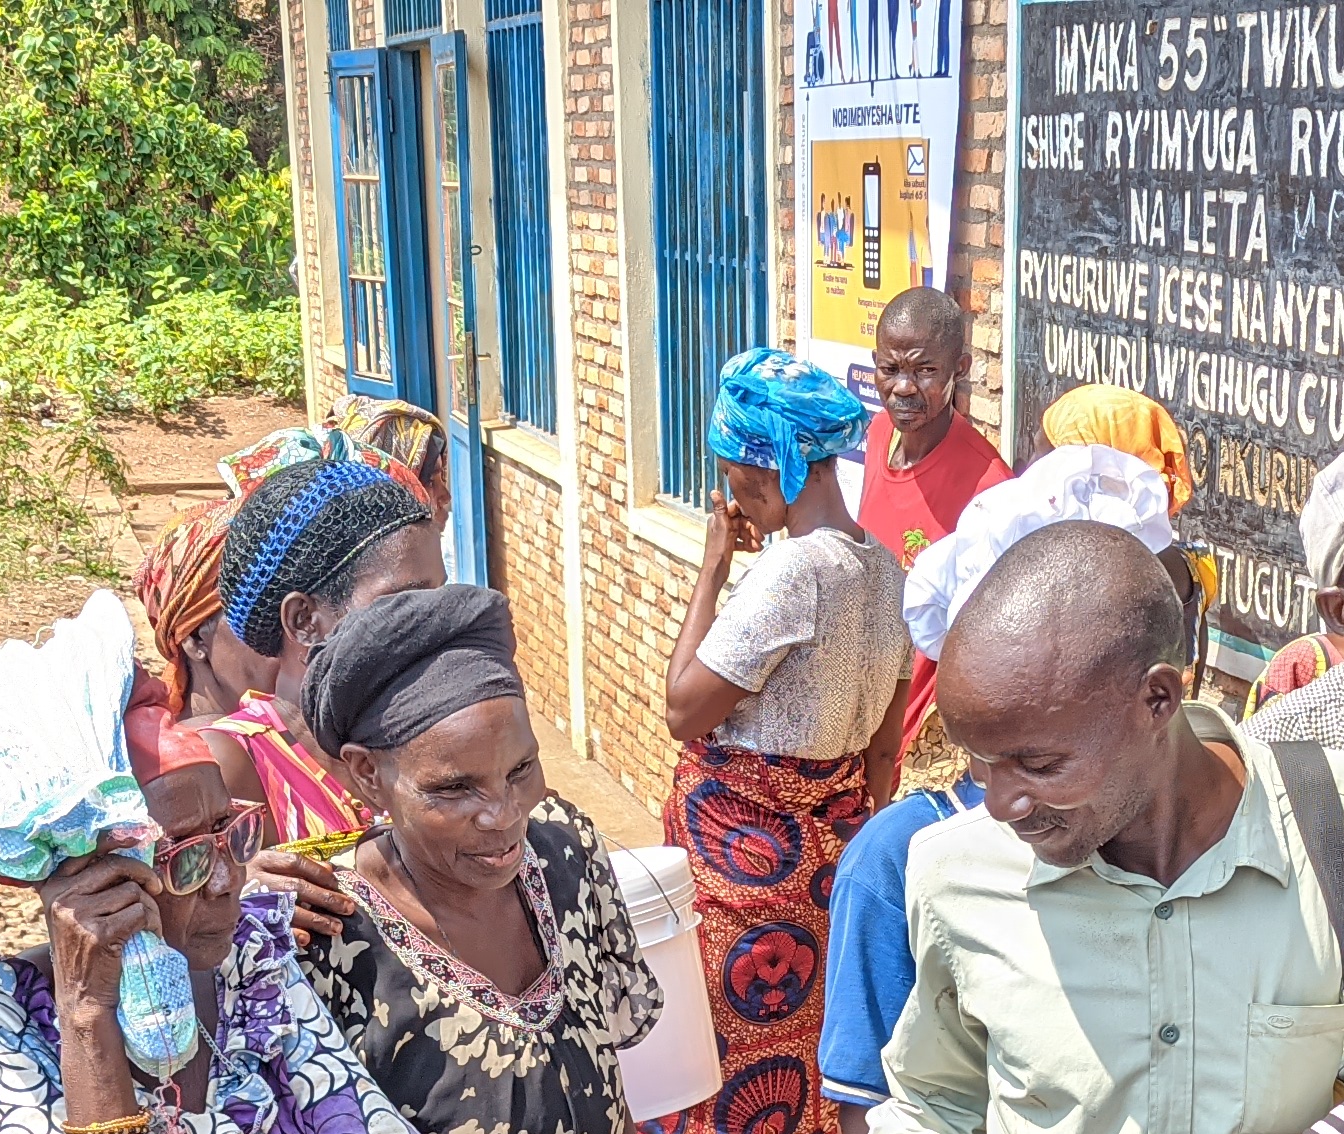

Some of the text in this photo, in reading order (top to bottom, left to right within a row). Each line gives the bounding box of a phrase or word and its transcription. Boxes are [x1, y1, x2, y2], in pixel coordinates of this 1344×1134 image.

[1055, 18, 1139, 96] IMYAKA
[832, 103, 920, 128] NOBIMENYESHA UTE
[1021, 111, 1085, 171] ISHURE
[1106, 107, 1258, 175] RY'IMYUGA
[1130, 187, 1166, 247] NA
[1183, 189, 1268, 262] LETA
[1020, 249, 1149, 321] RYUGURUWE
[1157, 265, 1224, 334] ICESE
[1231, 277, 1268, 345] NA
[1044, 323, 1147, 393] UMUKURU
[1153, 342, 1291, 428] W'IGIHUGU
